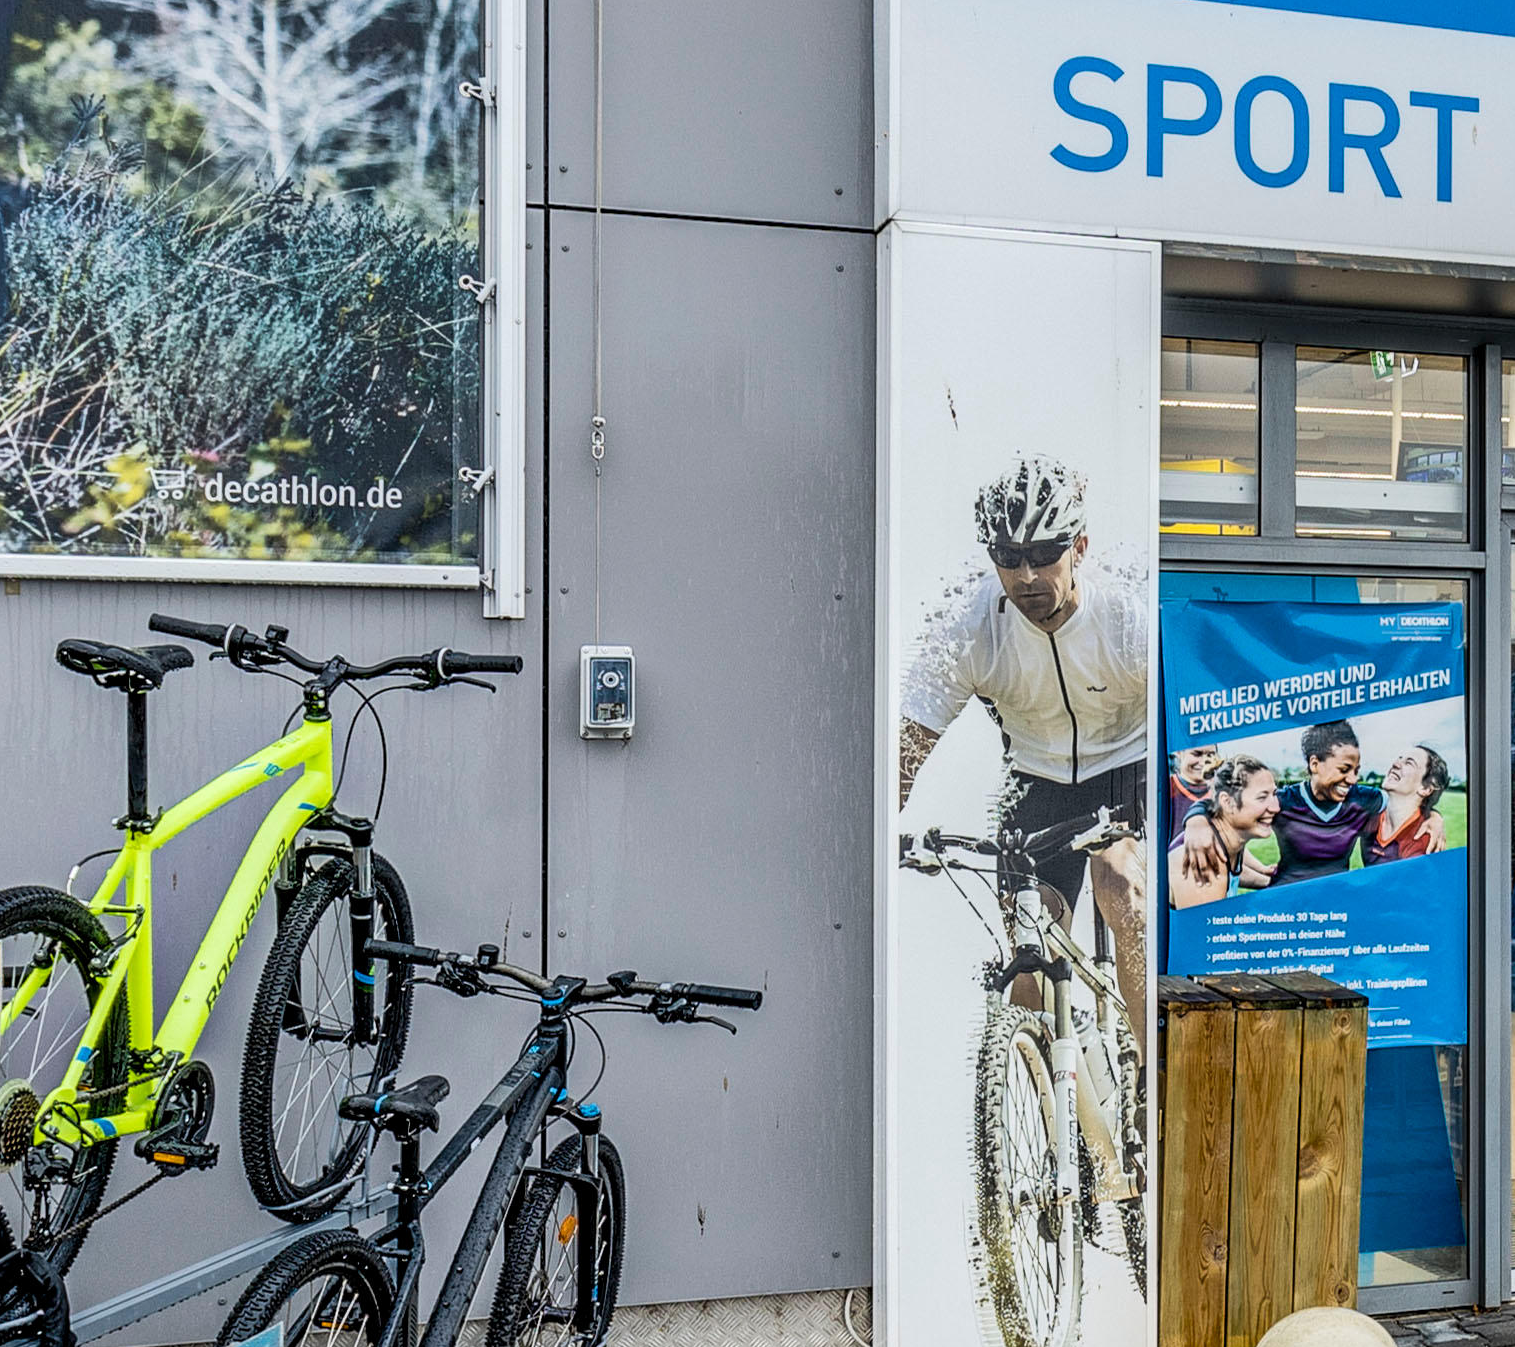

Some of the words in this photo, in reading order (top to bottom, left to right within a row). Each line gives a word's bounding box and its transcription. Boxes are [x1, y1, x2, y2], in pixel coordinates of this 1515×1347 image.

[1050, 55, 1480, 202] SPORT
[204, 472, 403, 510] decathlon.de
[1380, 617, 1396, 627] MY
[1180, 684, 1259, 715] MITGLIED
[1264, 669, 1336, 700] WERDEN
[1340, 663, 1376, 685] UND
[1189, 703, 1282, 736] EXKLUSIVE
[1286, 685, 1366, 716] VORTEILE
[1370, 668, 1451, 701] ERHALTEN
[205, 838, 286, 1014] ROCKRIDER
[1212, 916, 1232, 925] teste
[1233, 914, 1256, 924] deine
[1257, 913, 1295, 924] Produkte
[1296, 912, 1308, 922] 30
[1309, 912, 1328, 923] Tage
[1329, 911, 1347, 922] lang
[1212, 934, 1237, 943] erlebe
[1238, 930, 1287, 944] Sportevents
[1288, 930, 1297, 940] in
[1298, 929, 1324, 940] deiner
[1325, 928, 1346, 939] Nähe
[1212, 950, 1249, 962] profitiere
[1250, 950, 1265, 959] von
[1266, 948, 1281, 958] der
[1353, 944, 1370, 955] über
[1372, 943, 1387, 954] alle
[1388, 942, 1430, 953] Laufzeiten
[1366, 976, 1428, 990] Trainingsplänen
